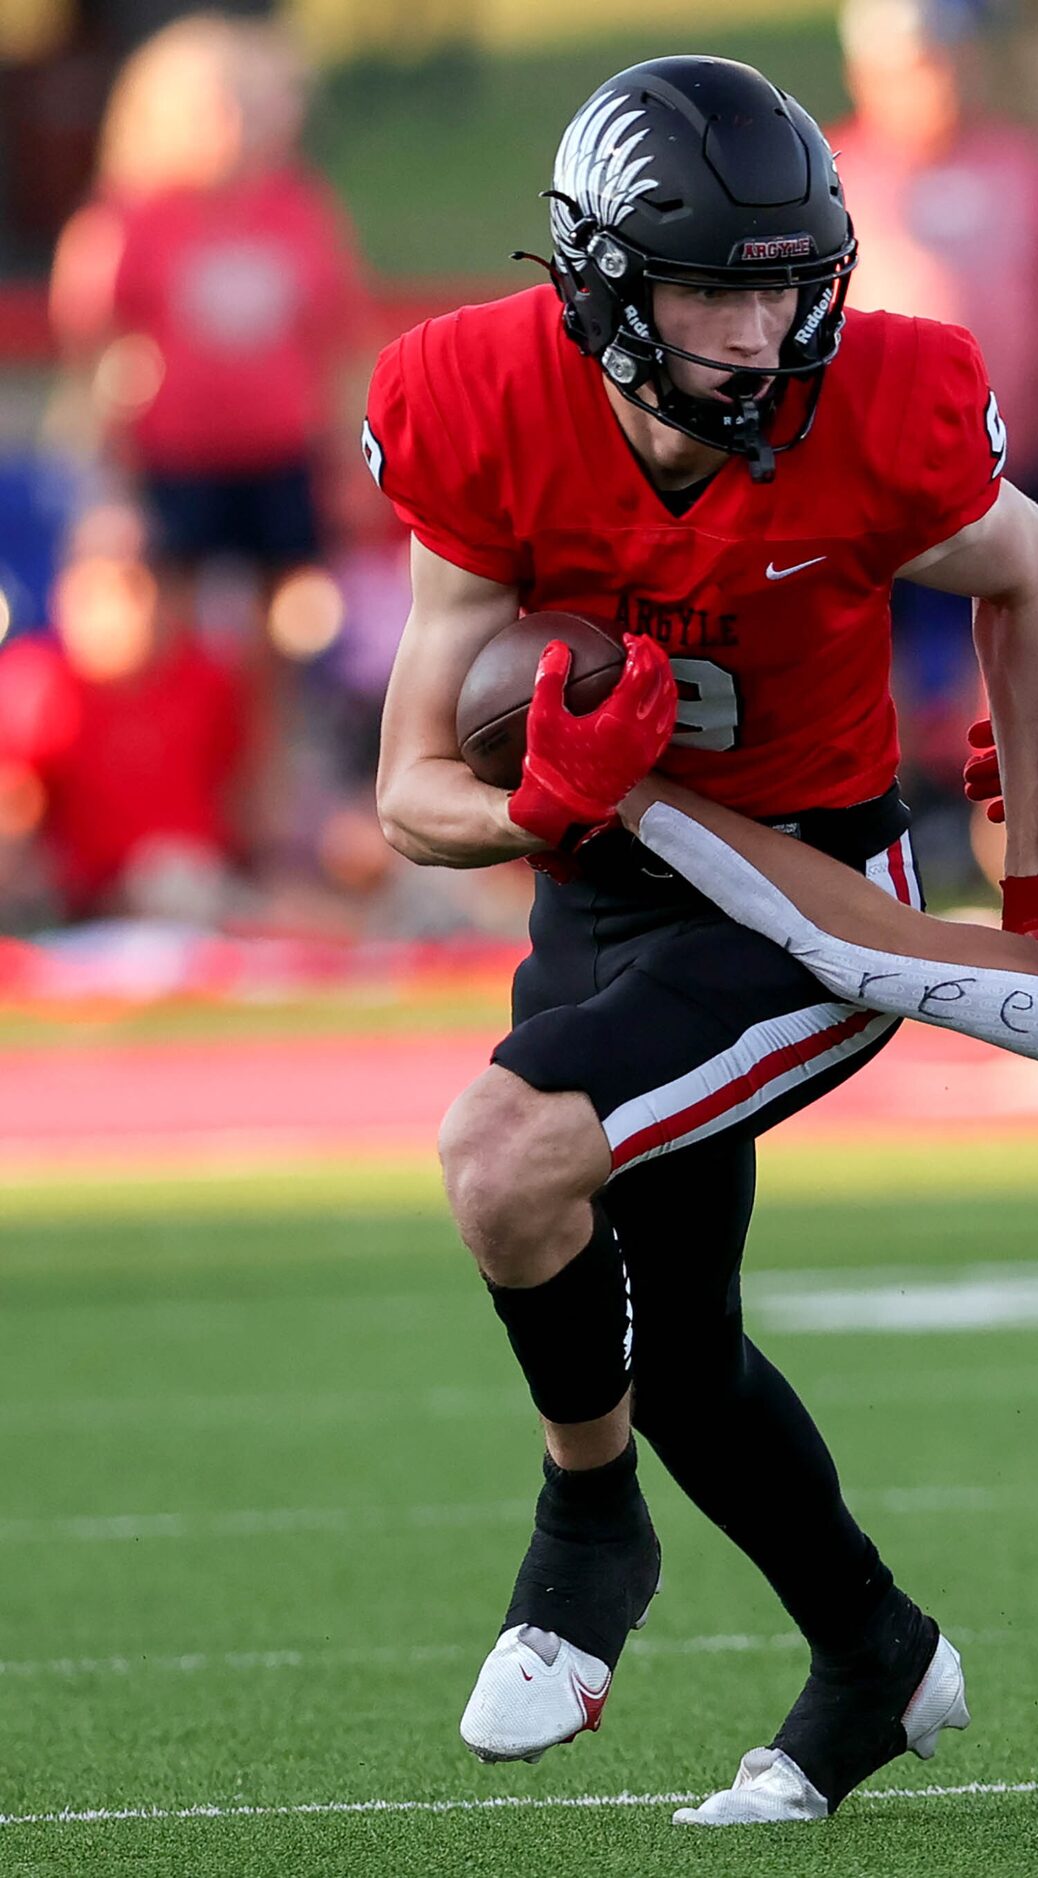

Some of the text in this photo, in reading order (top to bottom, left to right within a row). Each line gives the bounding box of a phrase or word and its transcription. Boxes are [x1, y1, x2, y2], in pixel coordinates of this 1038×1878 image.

[742, 238, 811, 260] ARGYLE
[795, 287, 833, 345] Riddell
[615, 592, 741, 649] ARGYLE
